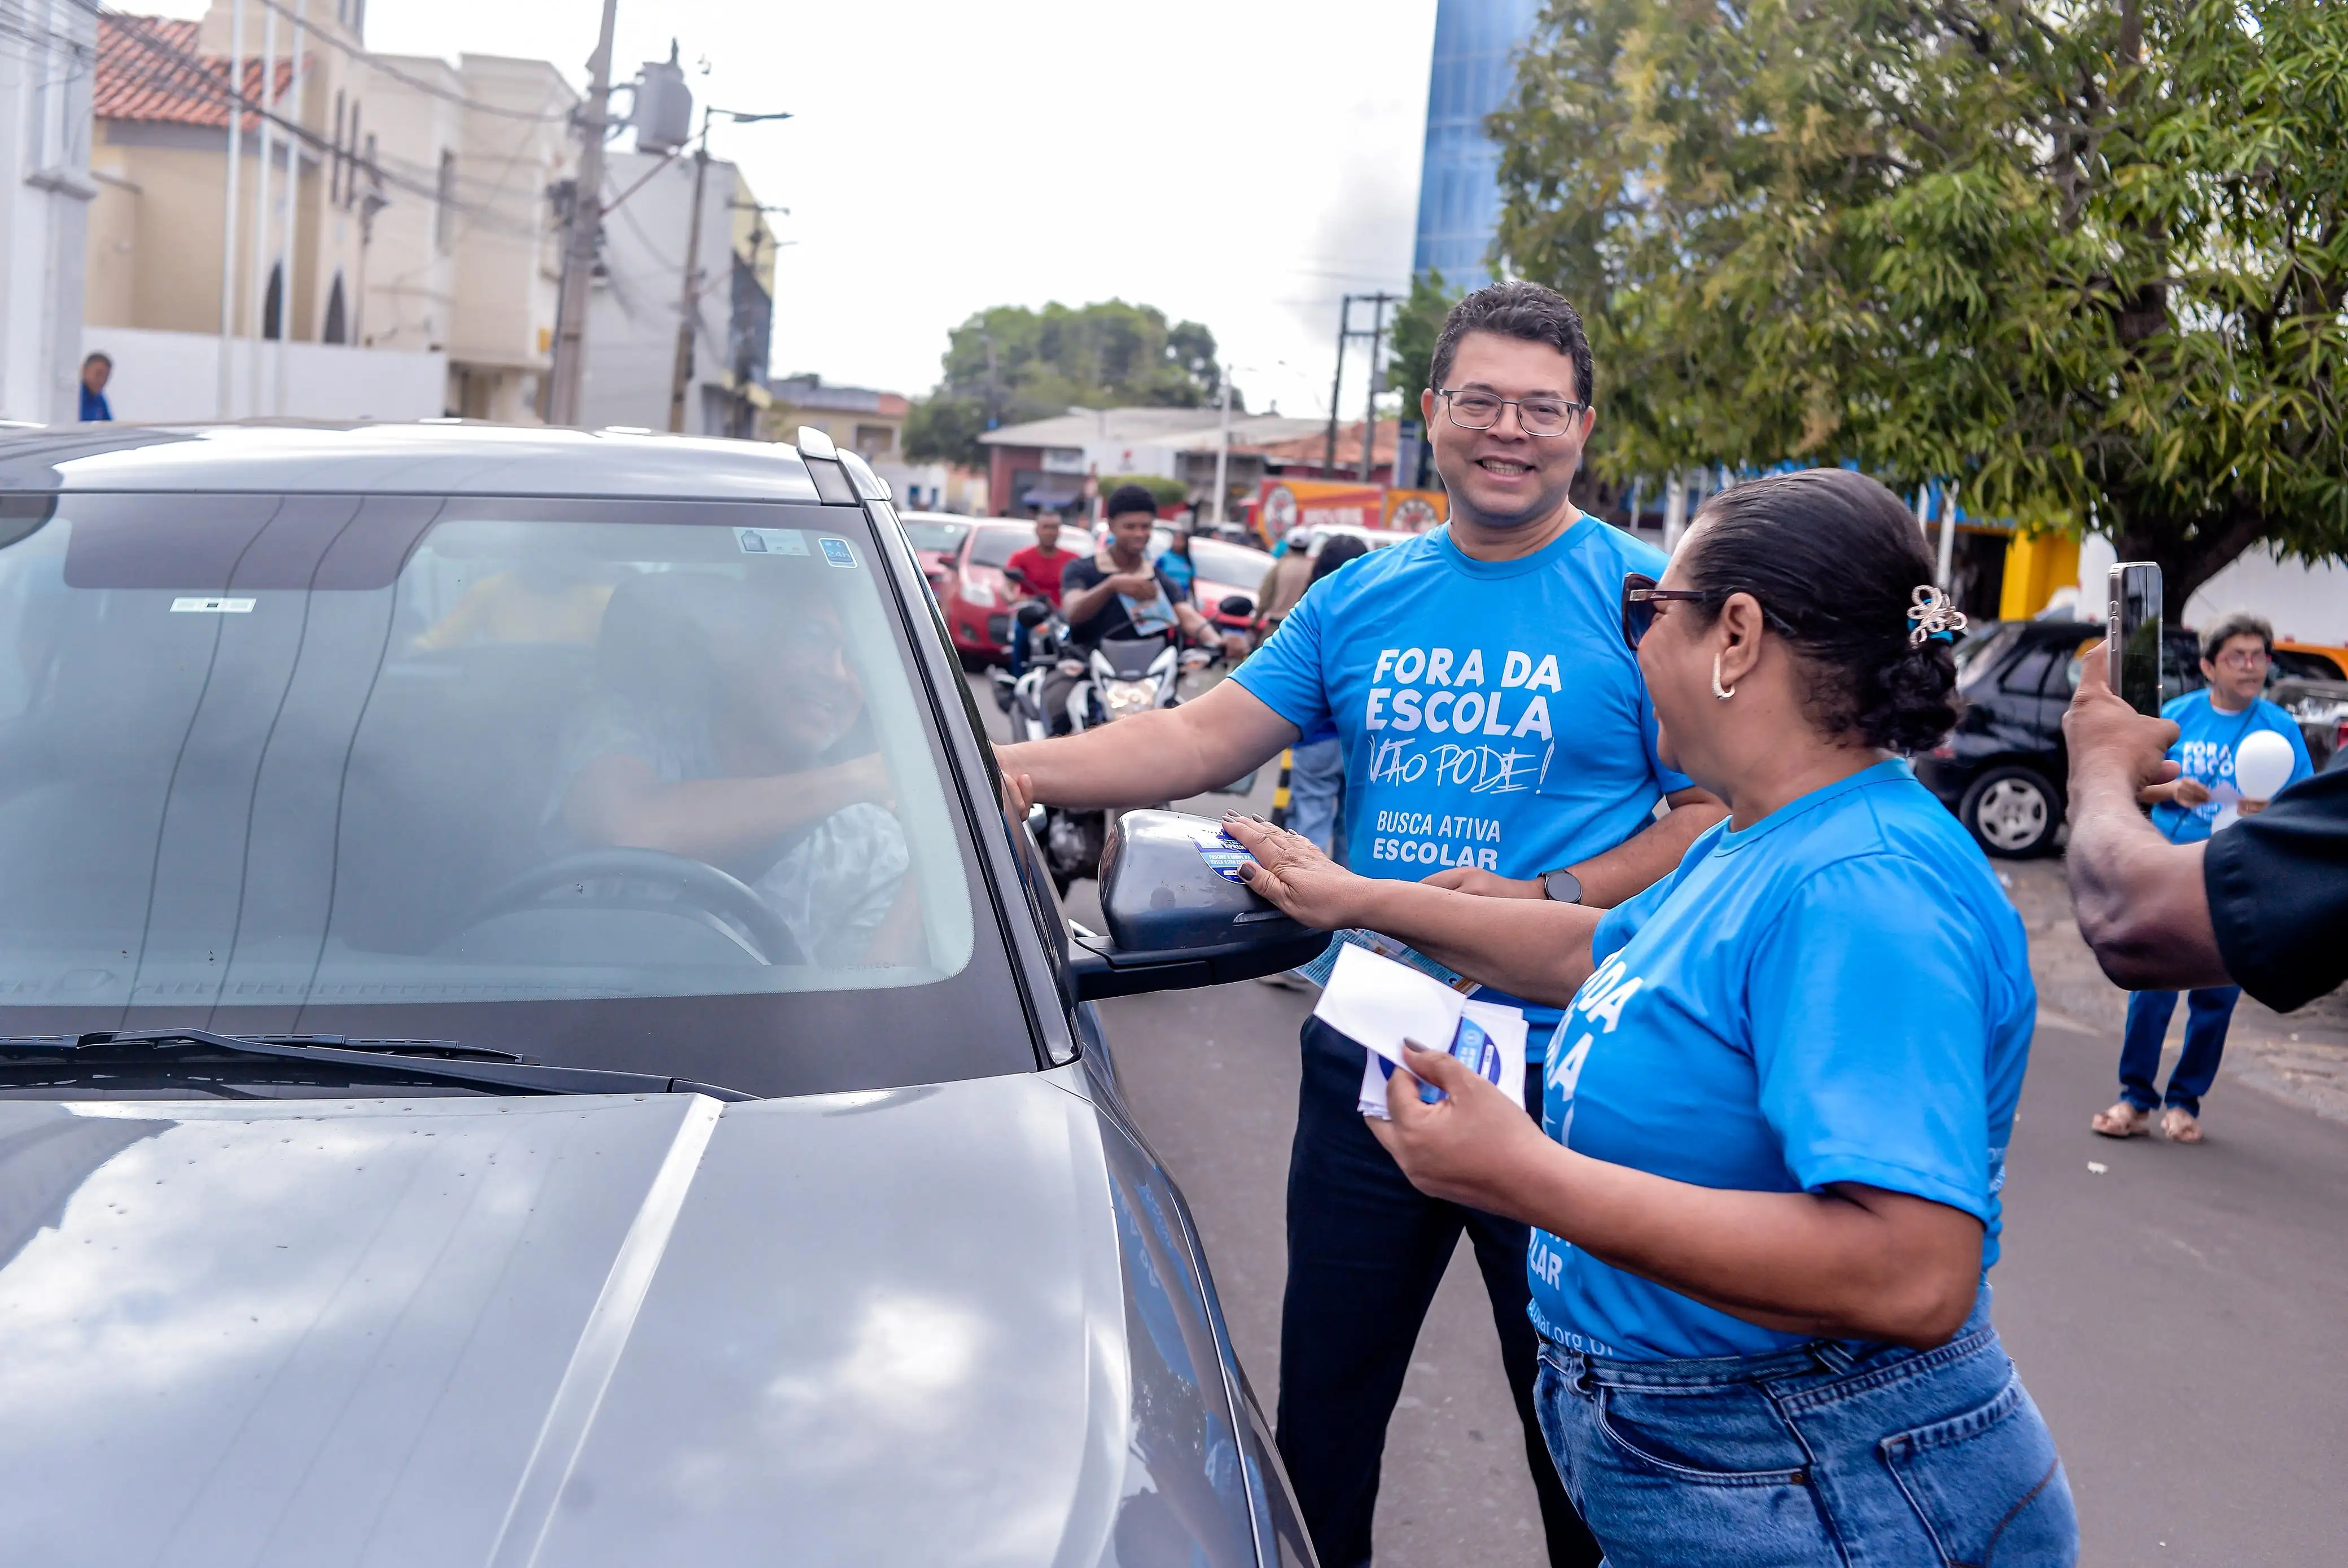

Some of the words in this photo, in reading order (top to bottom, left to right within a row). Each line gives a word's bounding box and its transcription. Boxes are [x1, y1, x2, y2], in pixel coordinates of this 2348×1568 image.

[1372, 647, 1485, 687] FORA
[1500, 650, 1562, 694] DA
[1366, 687, 1553, 741] ESCOLA
[1376, 810, 1433, 836] BUSCA
[1438, 814, 1501, 843] ATIVA
[1373, 838, 1499, 871] ESCOLAR
[1577, 961, 1644, 1034] DA
